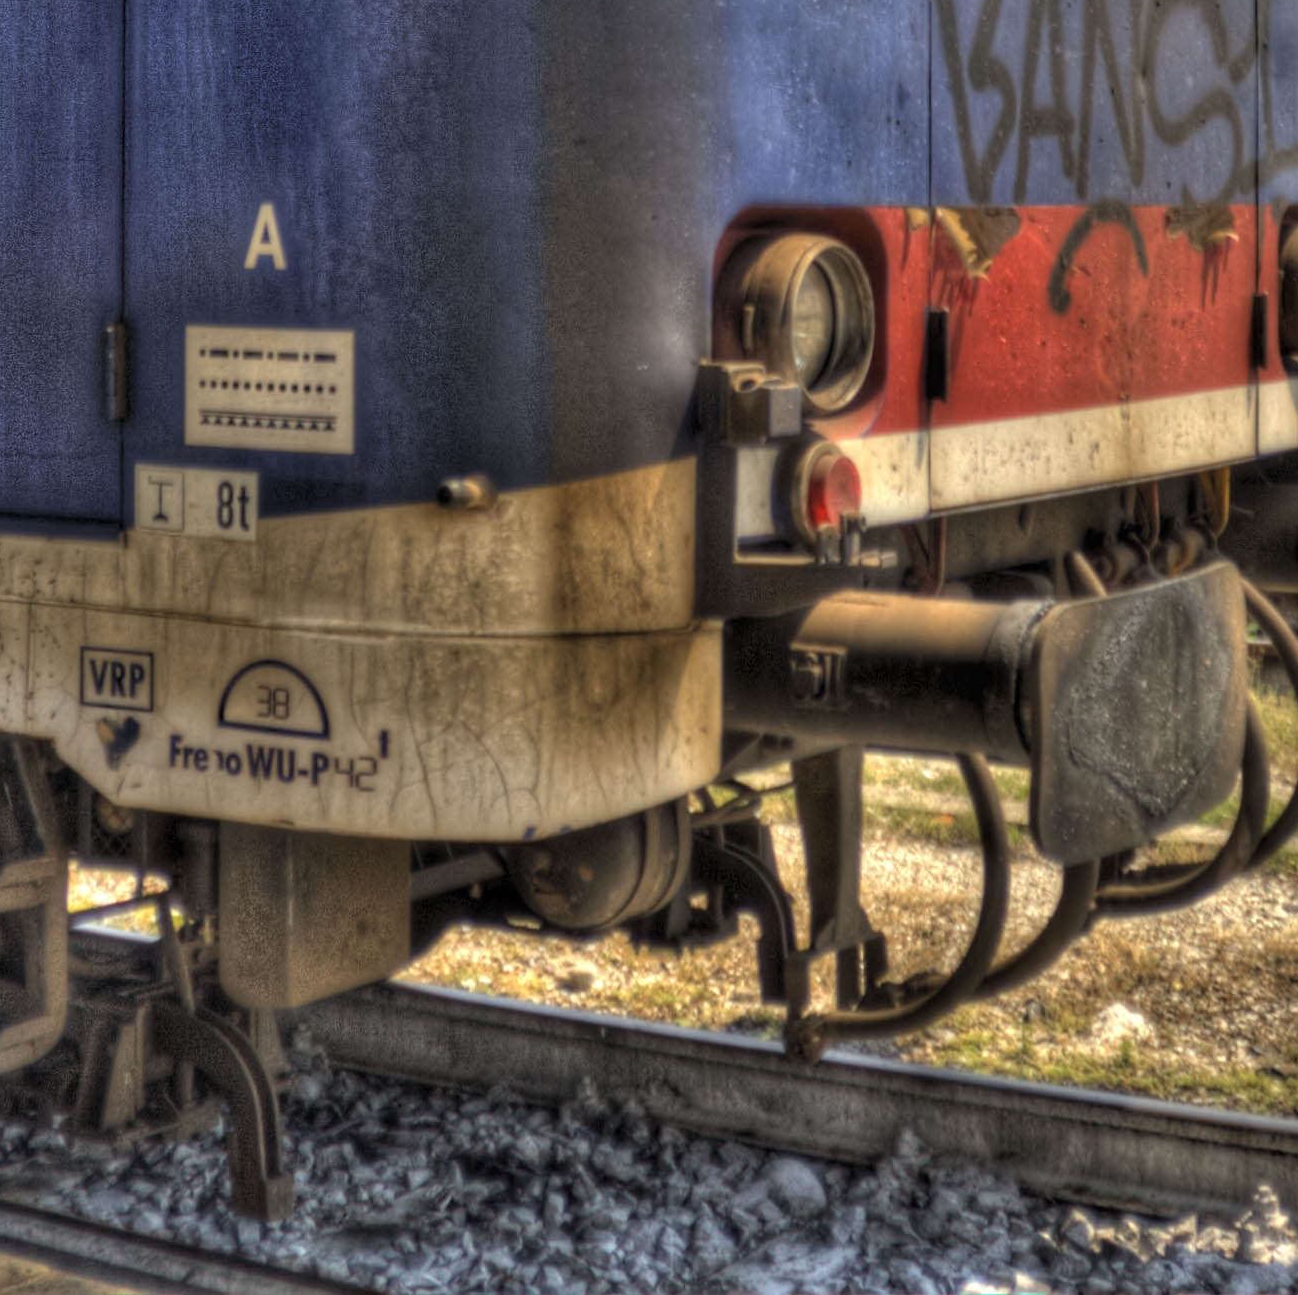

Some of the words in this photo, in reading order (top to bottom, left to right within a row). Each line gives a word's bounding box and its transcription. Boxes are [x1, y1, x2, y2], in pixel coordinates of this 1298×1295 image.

[244, 202, 287, 270] A
[89, 658, 146, 699] VRP
[256, 685, 290, 720] 38
[246, 744, 330, 786] WU-P
